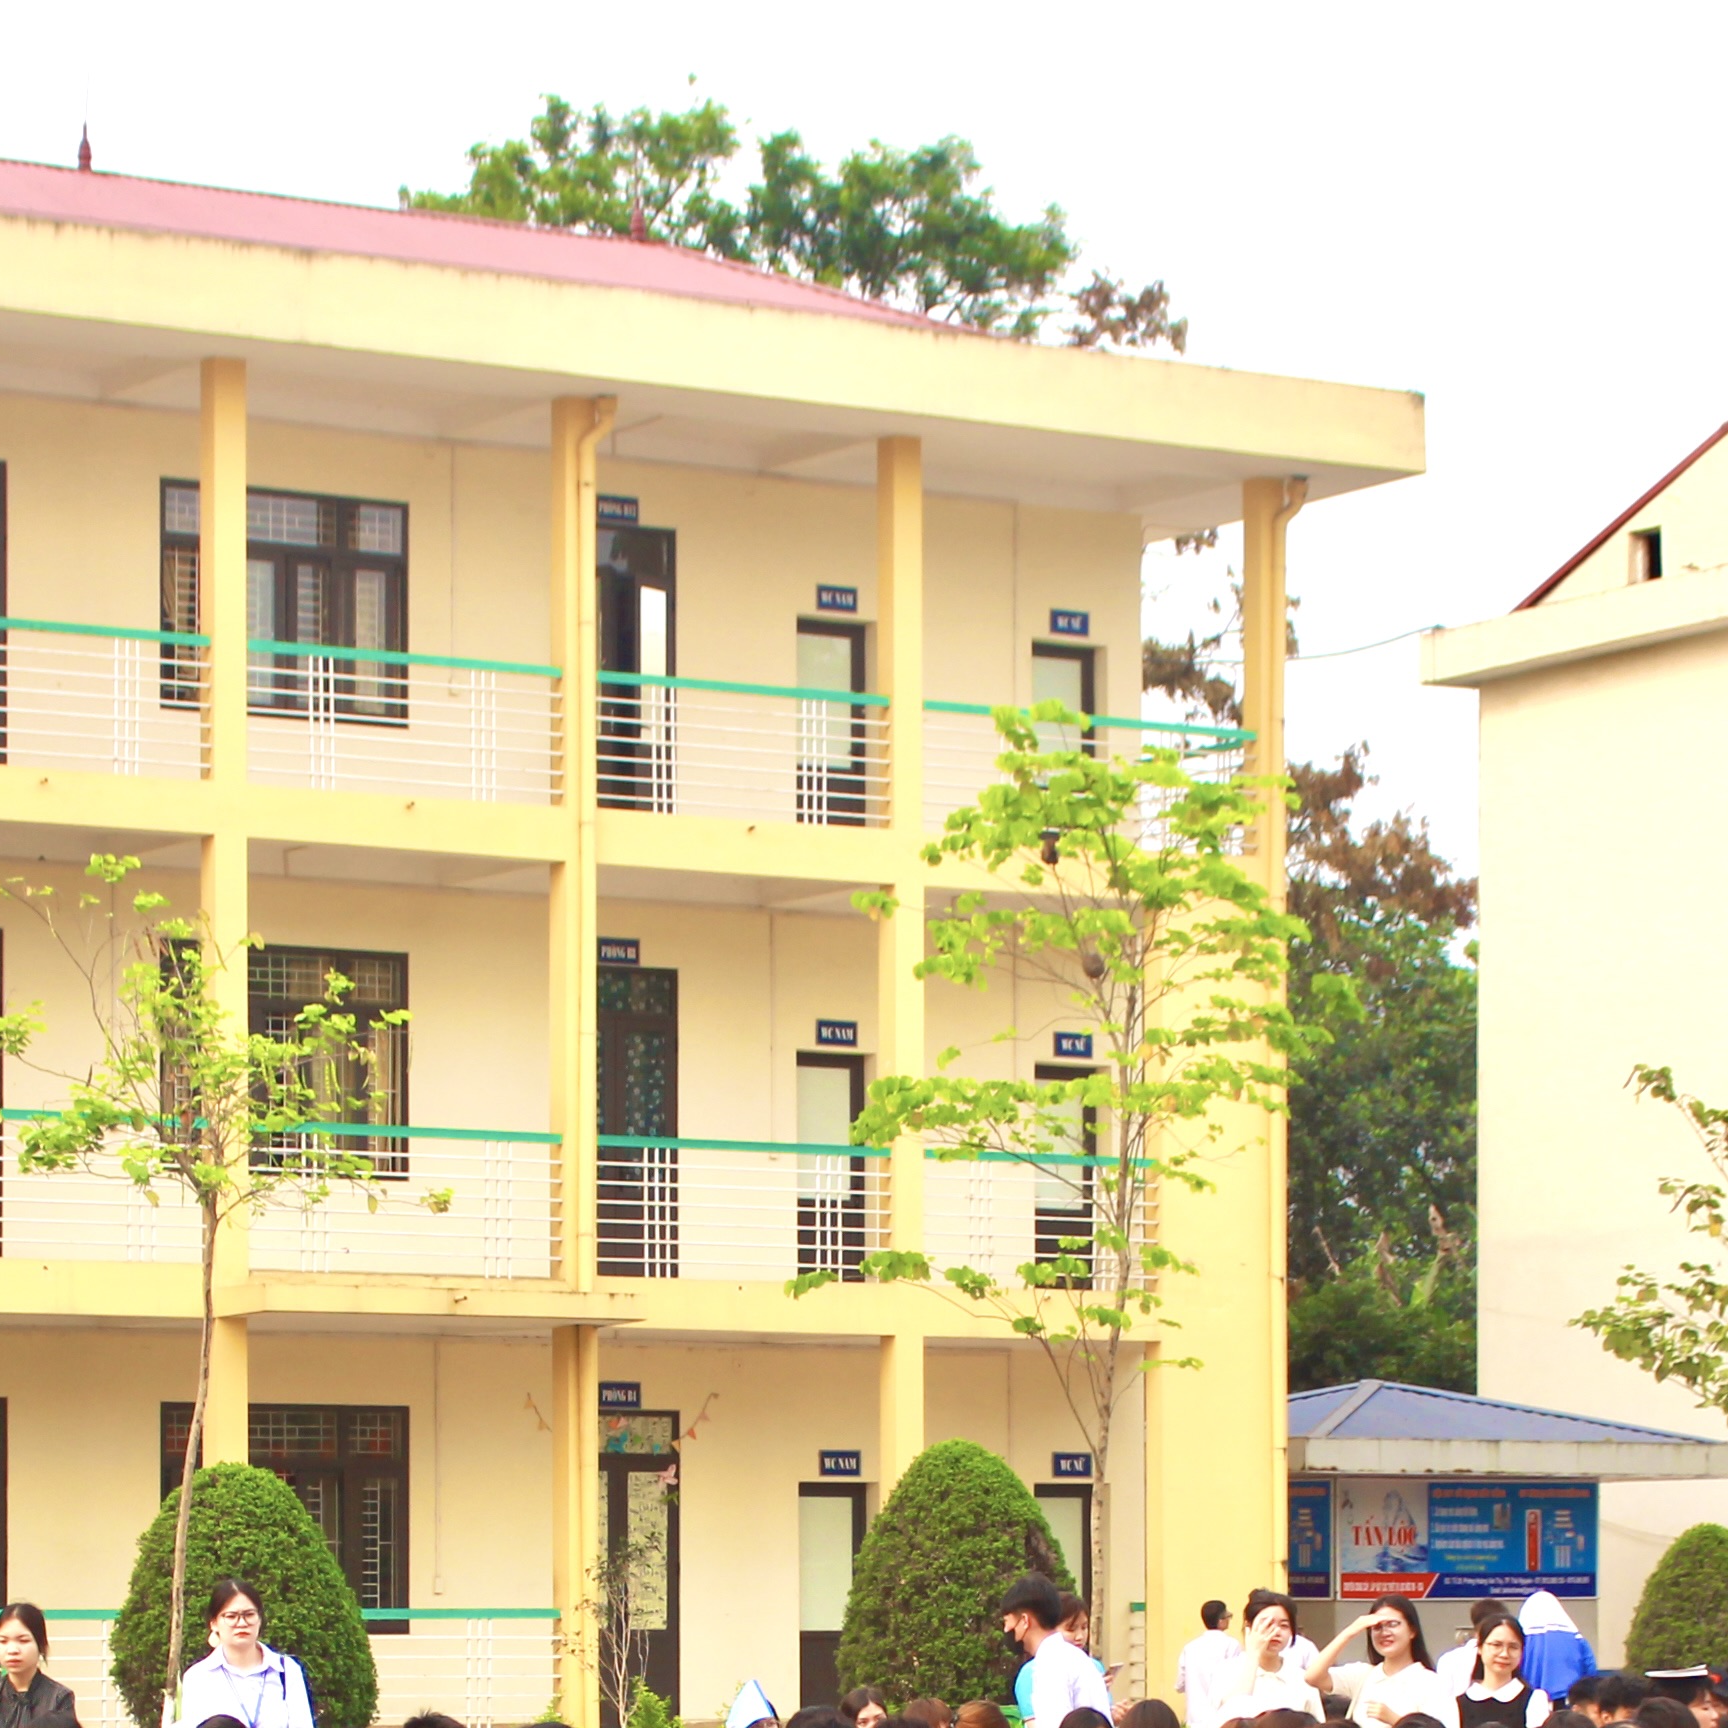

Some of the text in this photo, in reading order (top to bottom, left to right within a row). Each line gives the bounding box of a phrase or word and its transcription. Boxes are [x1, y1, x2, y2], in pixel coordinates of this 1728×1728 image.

[821, 1026, 853, 1041] WC NAM
[1061, 1038, 1072, 1051] WC
[824, 1457, 857, 1470] WC NAM
[1060, 1459, 1072, 1471] WC
[1352, 1514, 1417, 1553] TẤN LỘC
